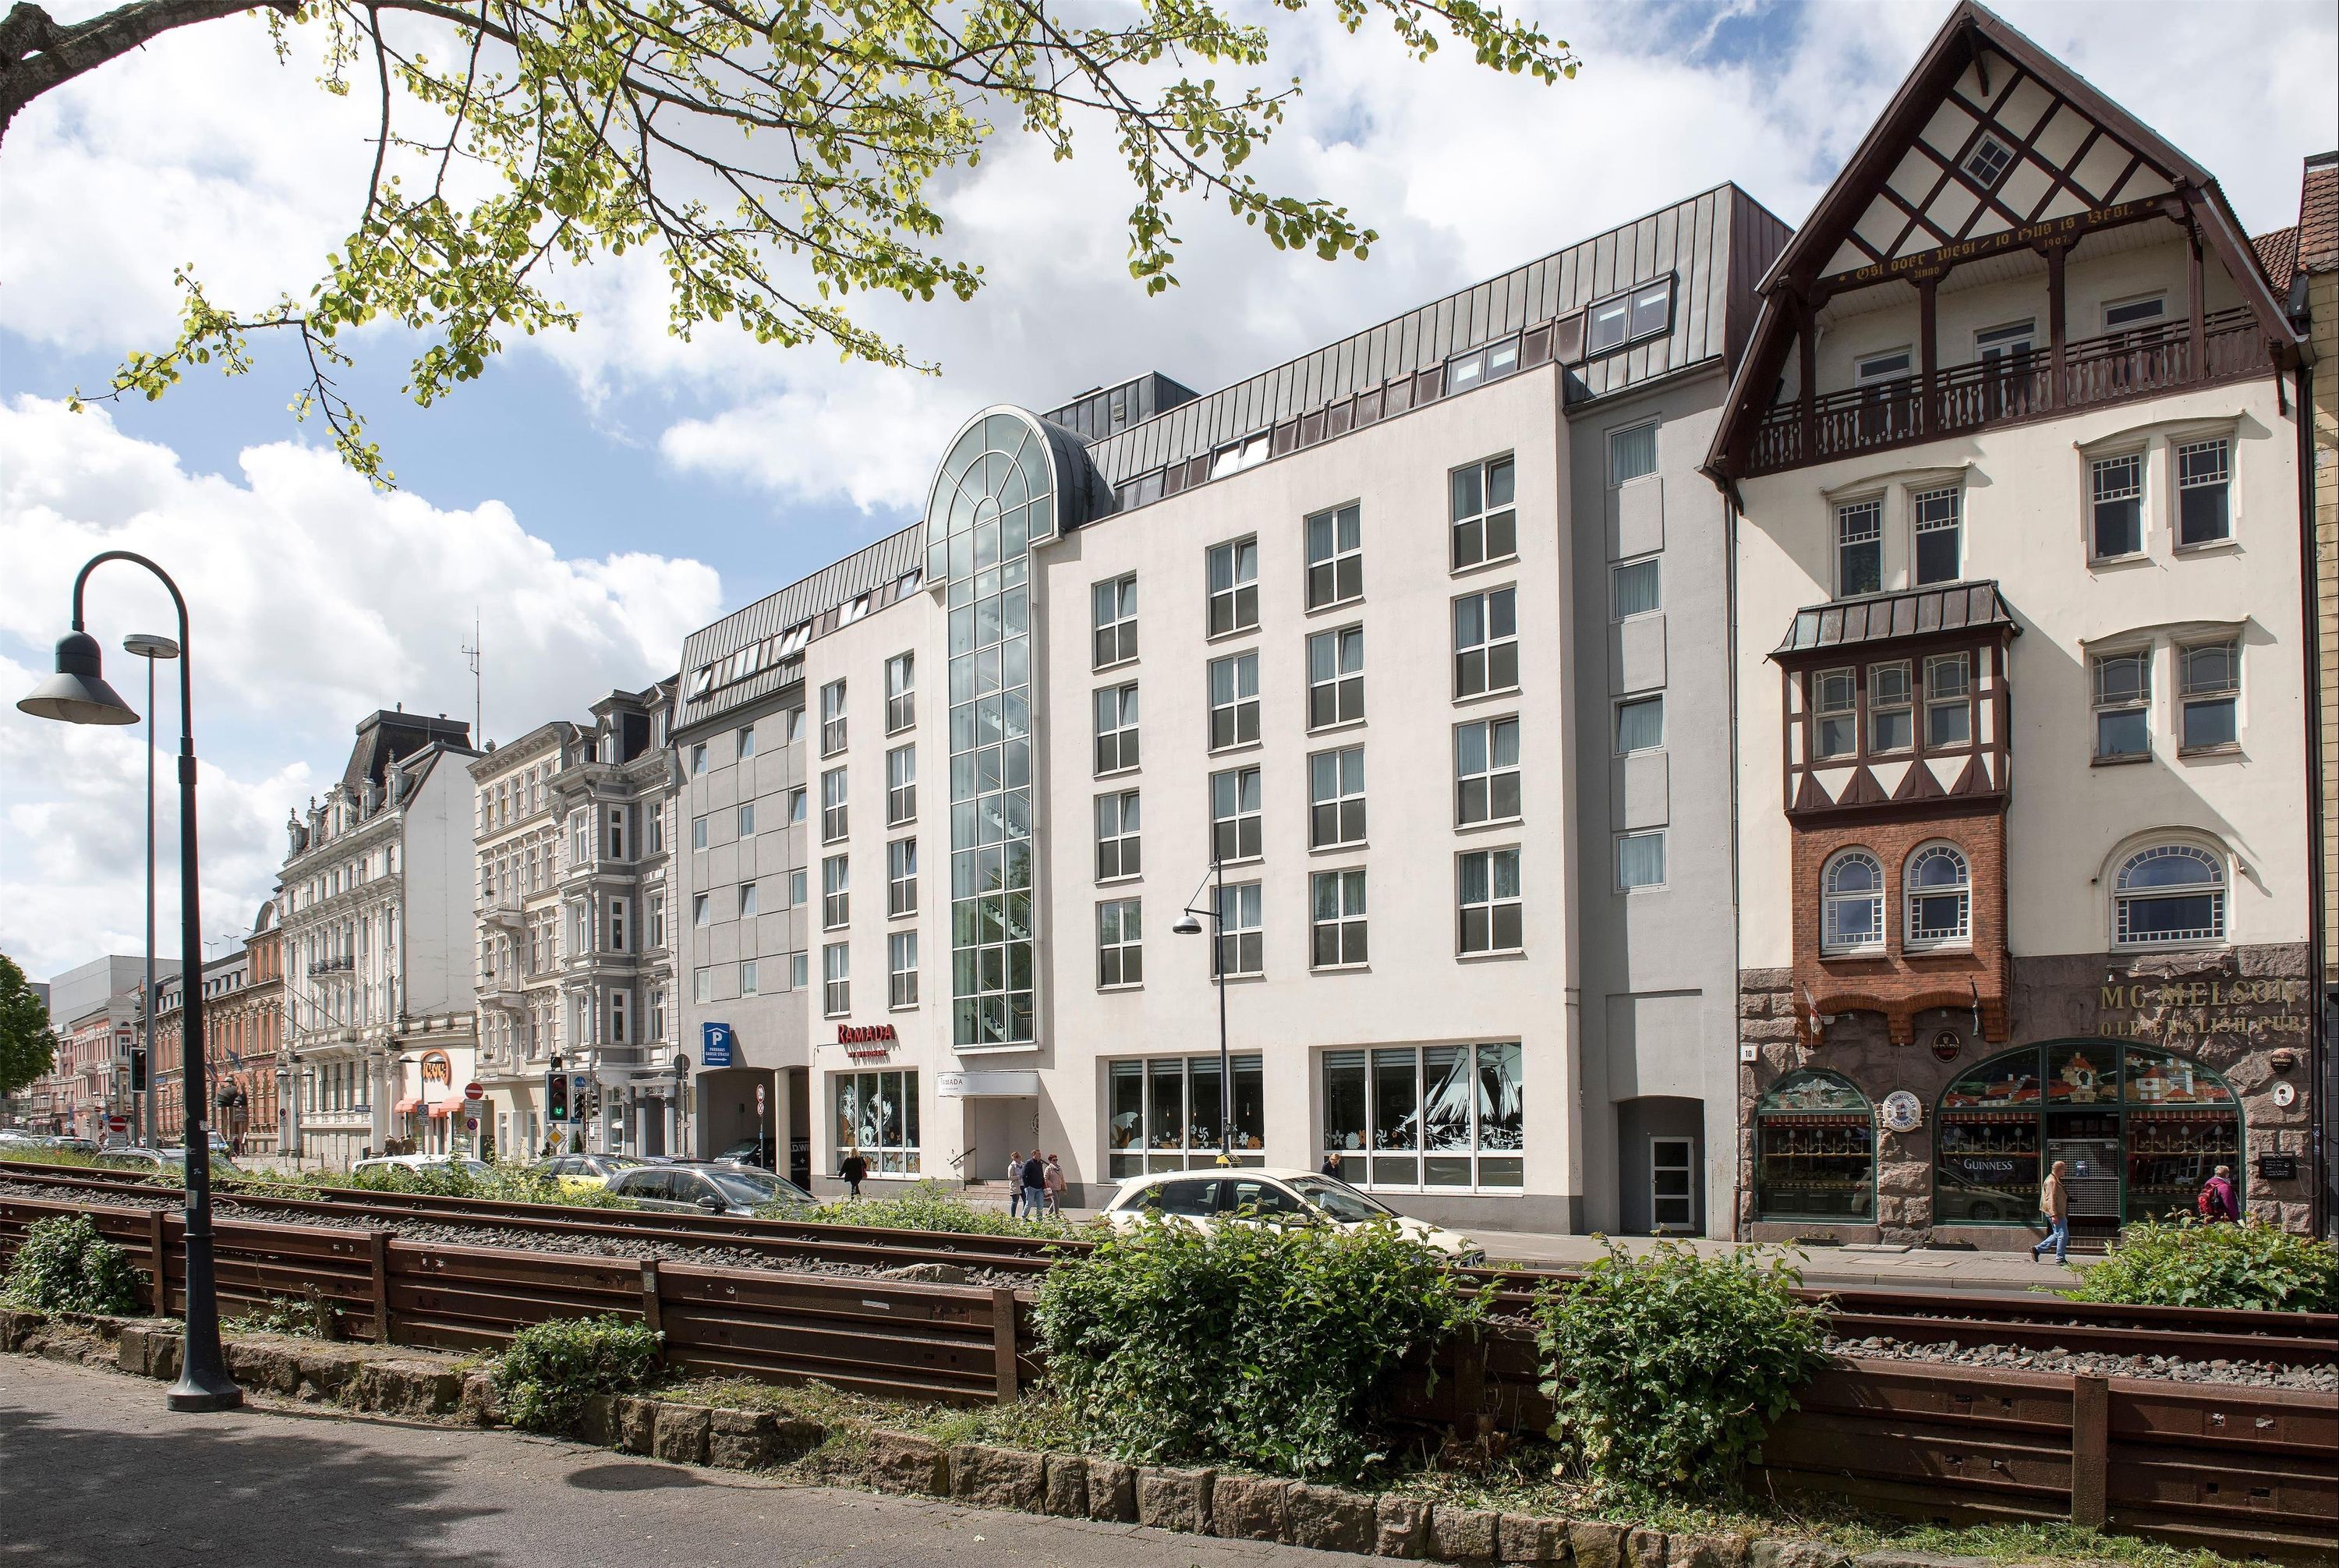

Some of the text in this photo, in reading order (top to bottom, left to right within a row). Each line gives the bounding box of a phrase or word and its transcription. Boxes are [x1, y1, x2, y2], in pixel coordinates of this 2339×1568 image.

[2100, 978, 2297, 1010] MC MELSON
[837, 1024, 896, 1044] RAMADA
[2100, 1015, 2301, 1037] OLD ENGLISH PUB
[713, 1032, 723, 1046] P
[1887, 1094, 1916, 1109] FLENSBURGER
[1963, 1158, 2014, 1170] GUINNESS
